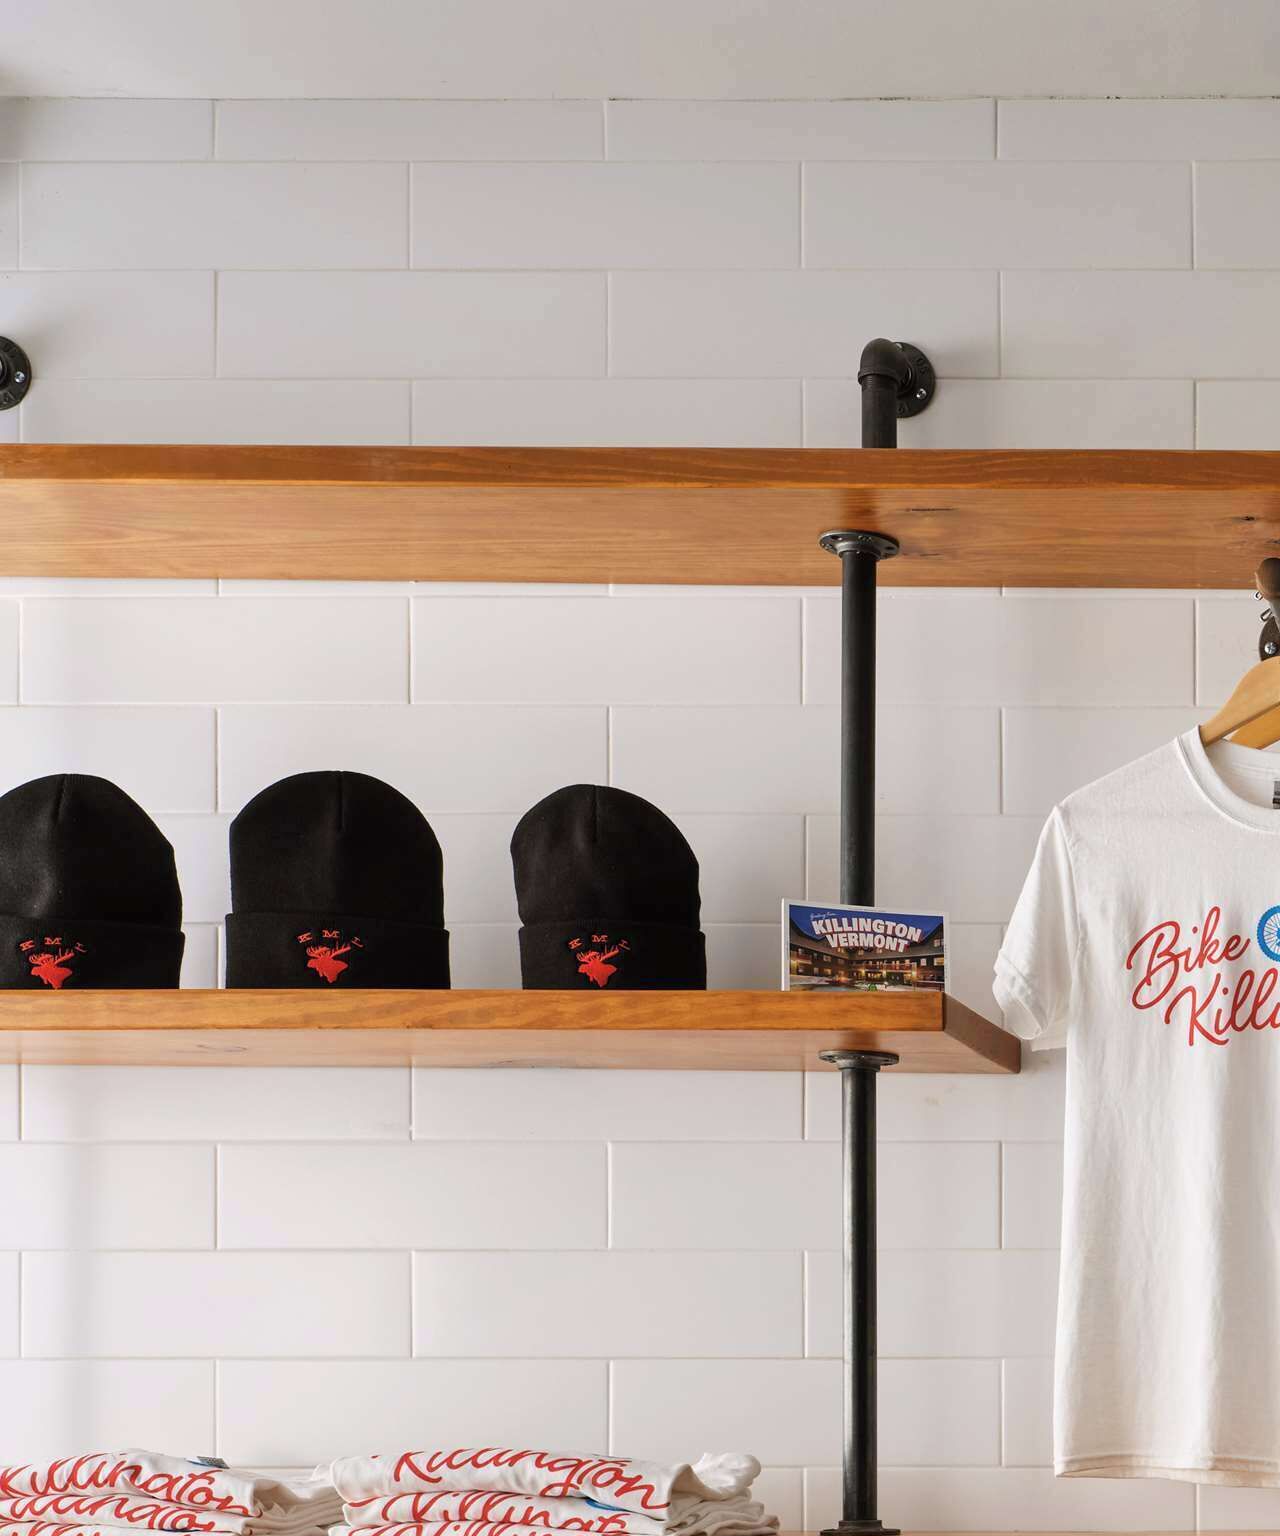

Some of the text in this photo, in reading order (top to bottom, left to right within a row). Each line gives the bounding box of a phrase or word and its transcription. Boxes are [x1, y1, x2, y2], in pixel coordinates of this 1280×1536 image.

[811, 916, 923, 943] KILLINGTON
[825, 932, 910, 953] VERMONT
[1125, 905, 1251, 1011] Bike
